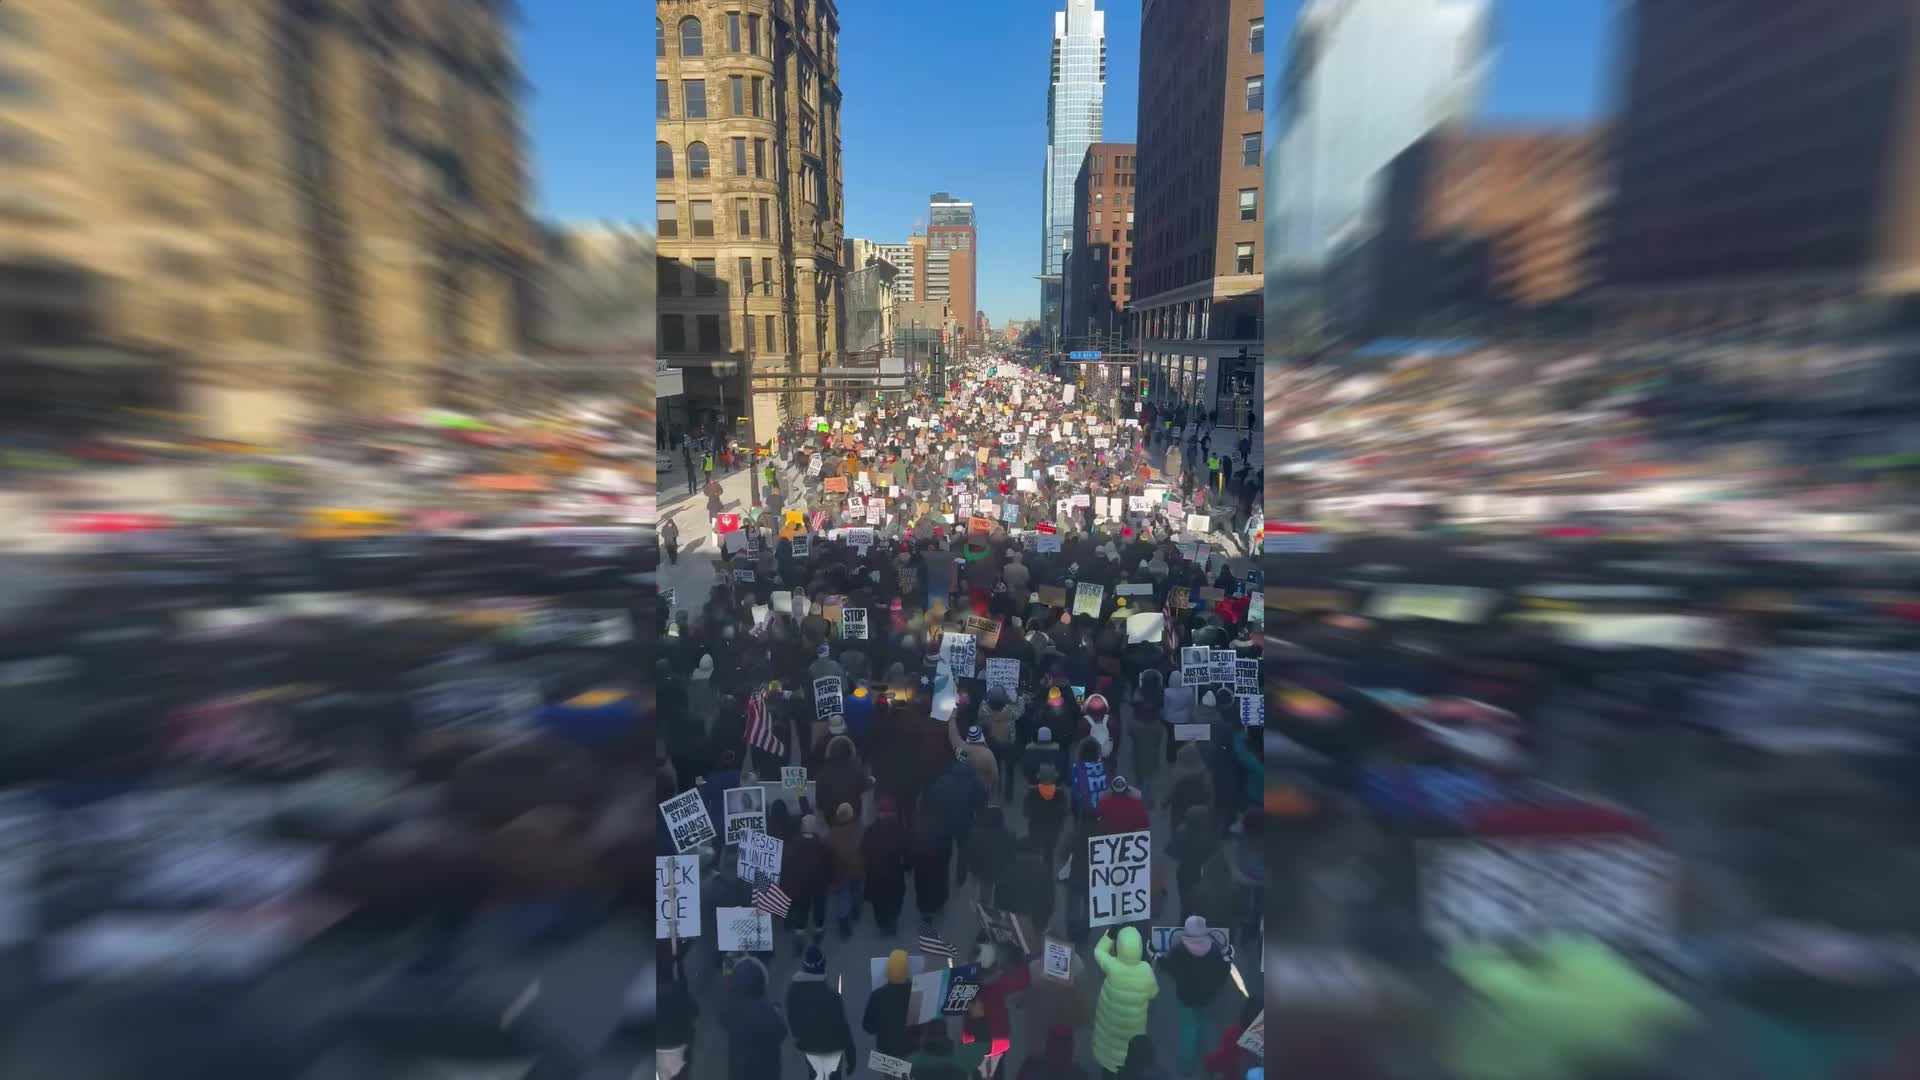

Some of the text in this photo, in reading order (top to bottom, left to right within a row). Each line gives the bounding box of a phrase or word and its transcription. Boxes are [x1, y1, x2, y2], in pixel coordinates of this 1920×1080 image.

[844, 609, 865, 622] STOP
[1221, 652, 1235, 662] OUT
[1184, 667, 1208, 677] JUSTICE
[1236, 669, 1256, 678] STRIKE
[818, 685, 838, 697] STANDS
[819, 705, 842, 718] ICE
[662, 792, 699, 815] MINNESOTA
[671, 802, 700, 823] STANDS
[673, 814, 709, 840] AGAINST
[728, 816, 764, 831] JUSTICE
[677, 826, 714, 850] ICE
[751, 832, 780, 851] RESIST
[1090, 835, 1149, 865] EYES
[1091, 864, 1146, 888] NOT
[656, 896, 687, 921] CE
[1092, 888, 1147, 918] LIES
